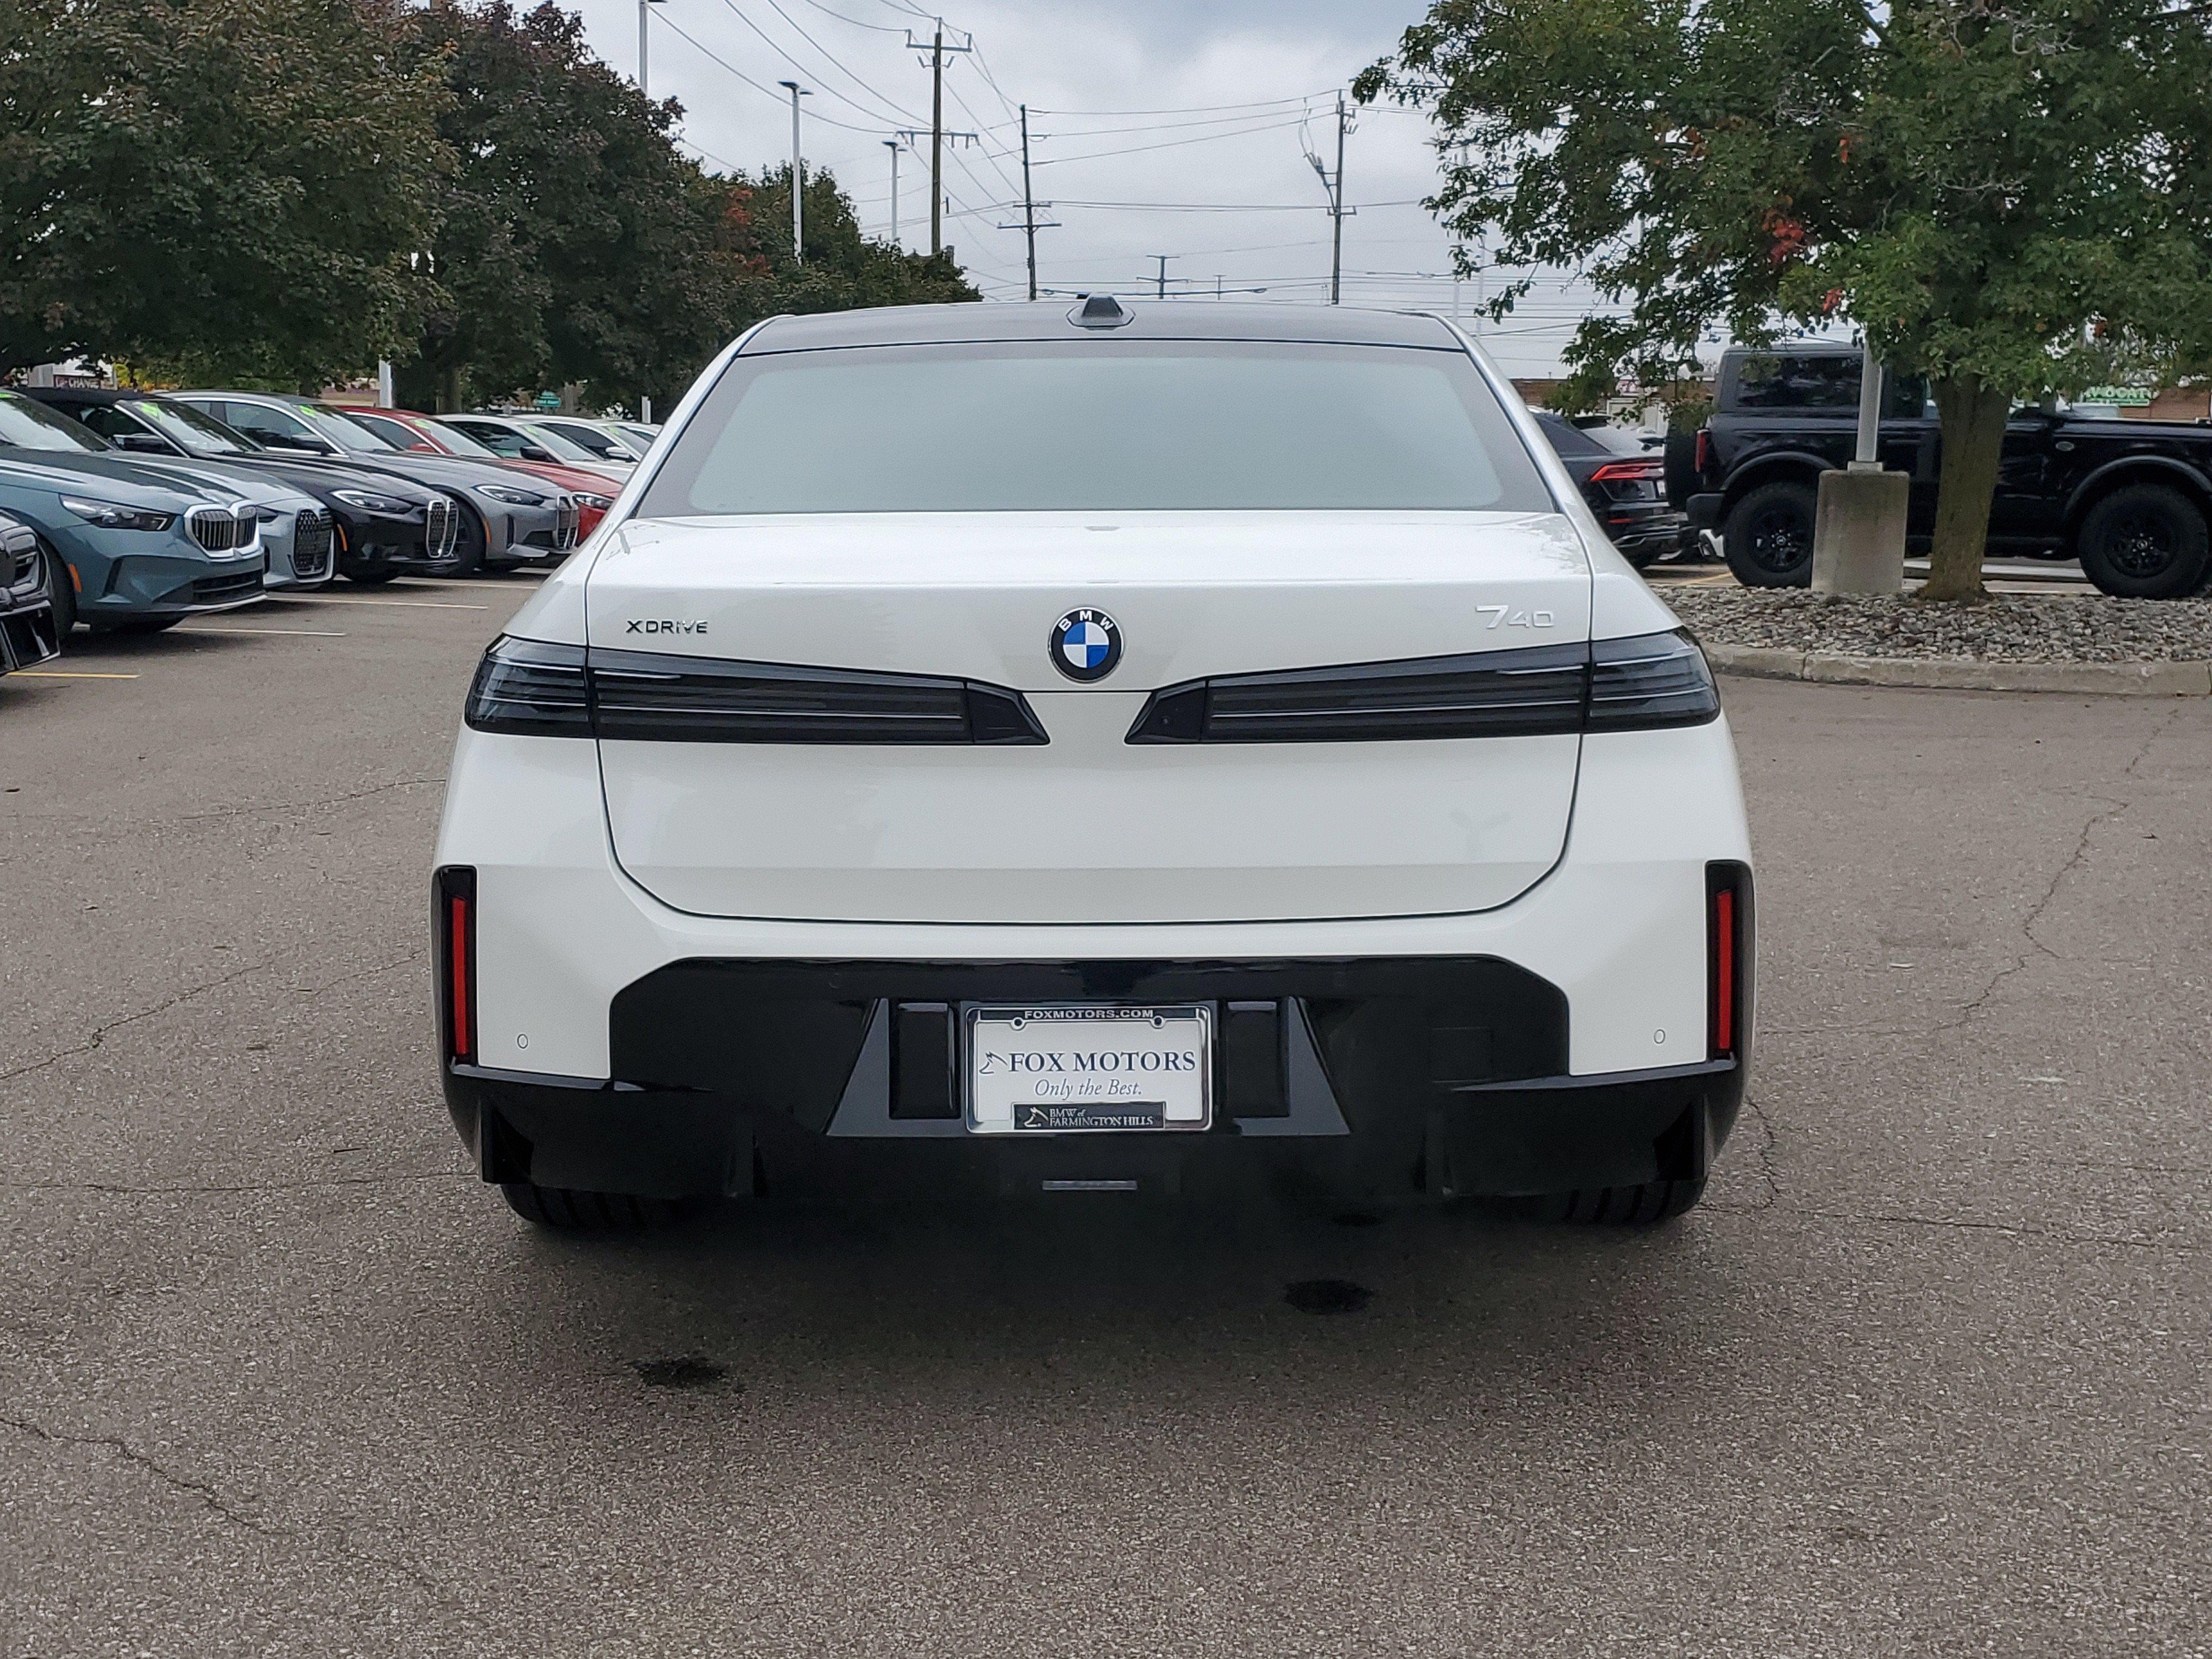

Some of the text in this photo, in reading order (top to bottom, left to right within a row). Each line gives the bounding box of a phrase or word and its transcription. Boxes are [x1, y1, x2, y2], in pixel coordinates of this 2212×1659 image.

[1058, 610, 1114, 632] BMW
[1475, 605, 1555, 629] 740
[625, 619, 708, 634] XDRIVE
[1024, 1009, 1154, 1019] FOXMOTORS.COM
[1008, 1051, 1196, 1072] FOX MOTORS
[1035, 1078, 1142, 1100] Only the Best.
[1049, 1108, 1086, 1117] BMW of
[1049, 1116, 1154, 1127] FARMINGTON HILLS
